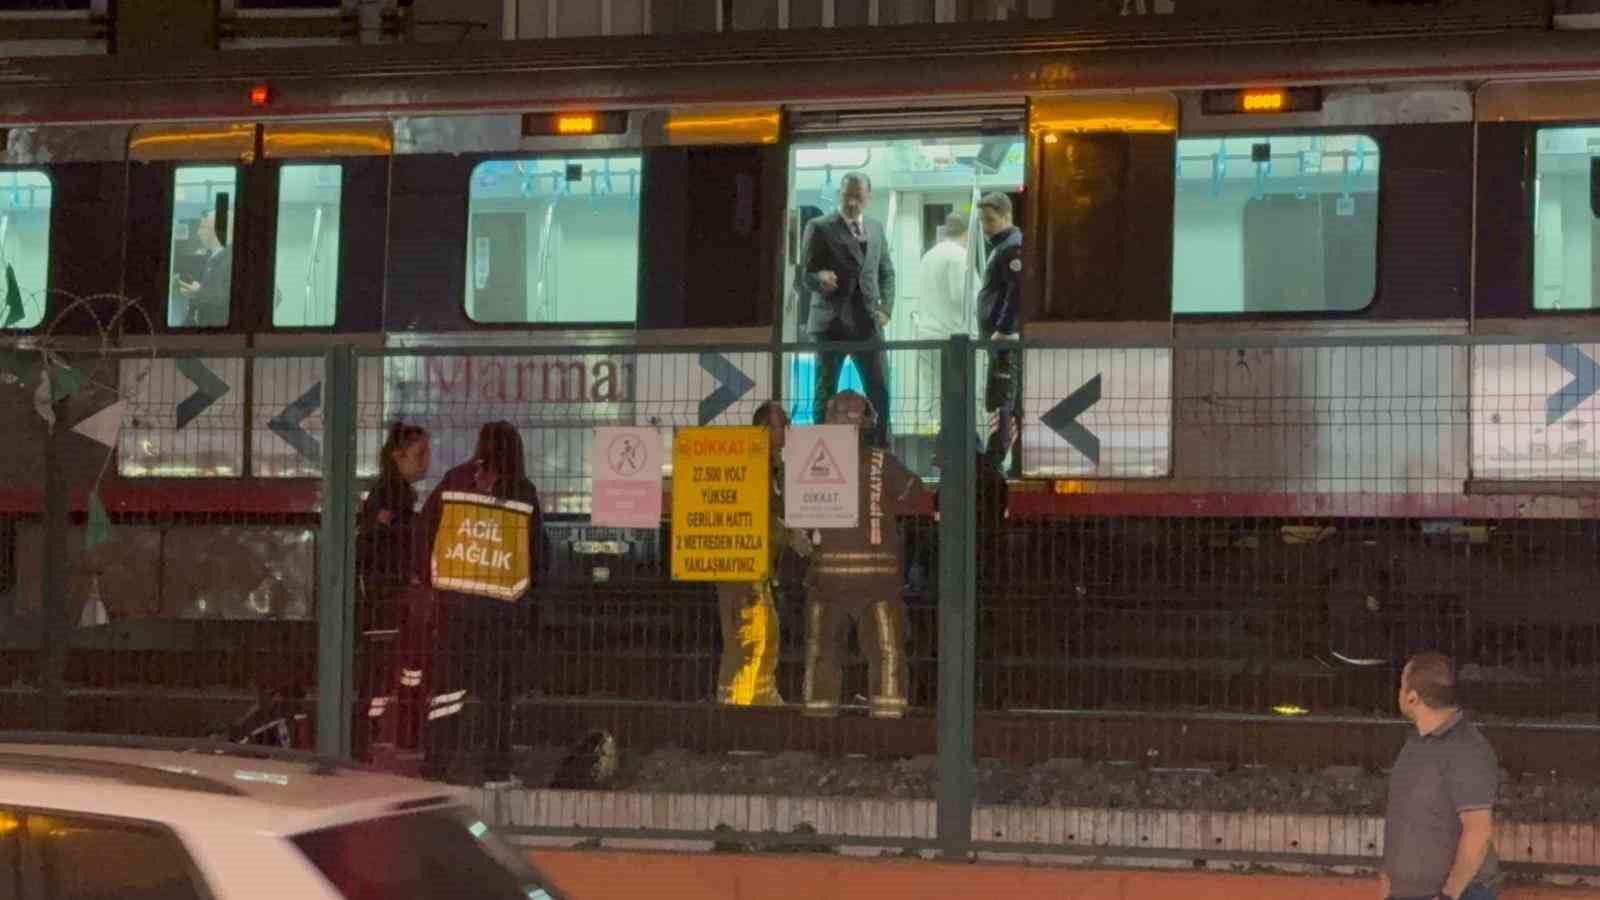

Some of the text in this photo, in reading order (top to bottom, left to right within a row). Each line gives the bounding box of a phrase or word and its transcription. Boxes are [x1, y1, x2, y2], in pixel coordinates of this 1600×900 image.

[724, 465, 747, 482] VOLT
[702, 487, 737, 504] YÜKSEK
[457, 517, 503, 543] ACİL
[676, 534, 762, 550] 2 METREDEN FAZLA
